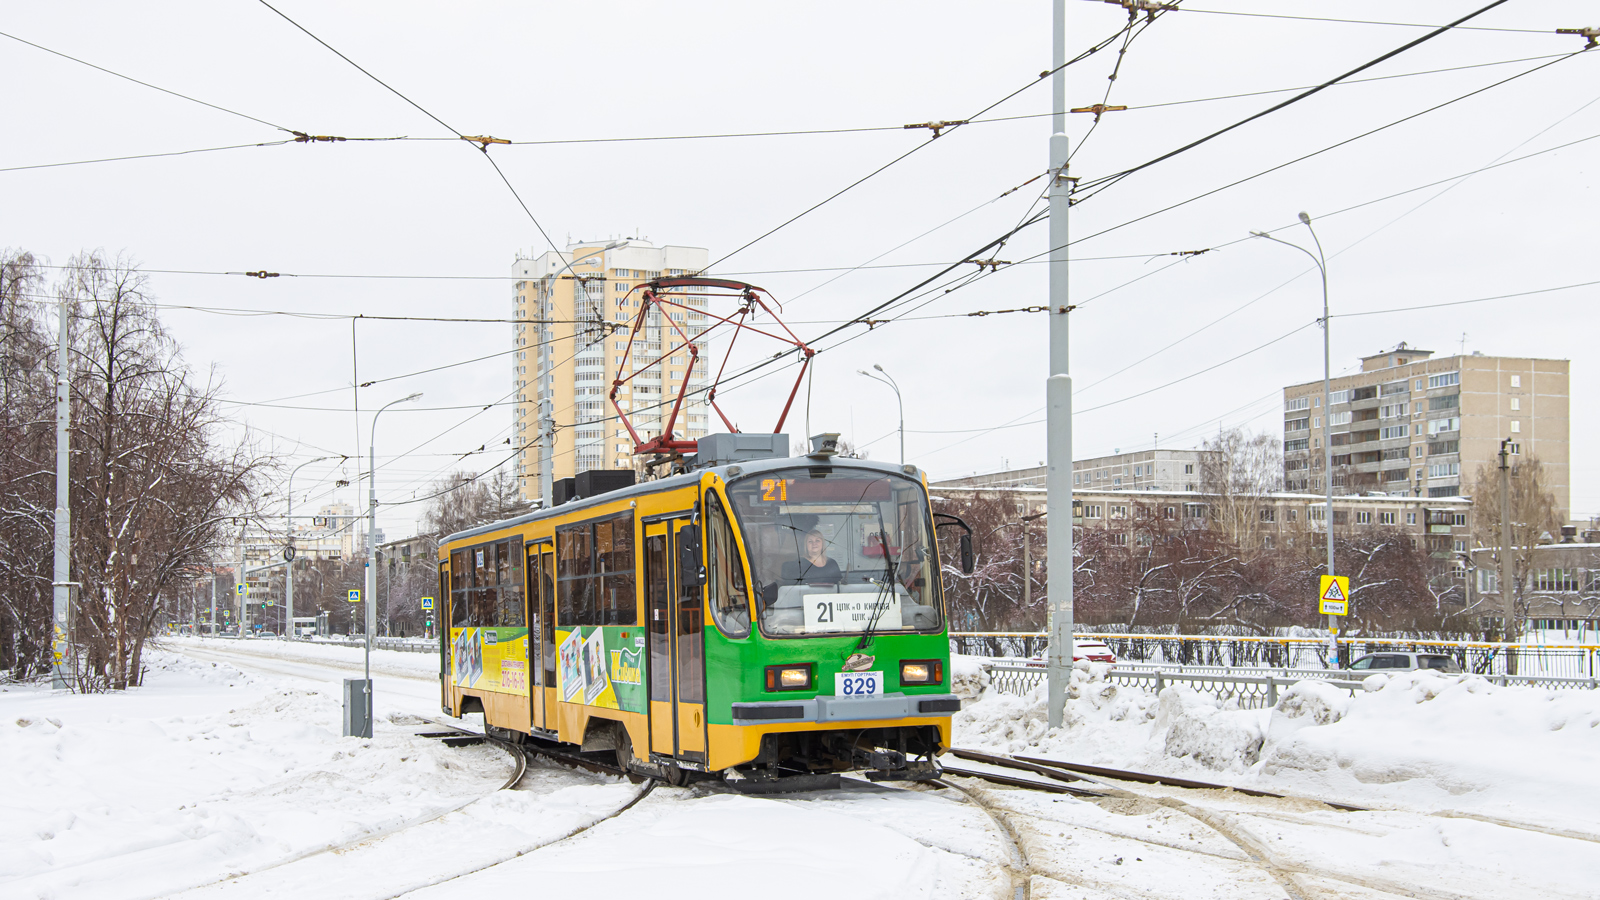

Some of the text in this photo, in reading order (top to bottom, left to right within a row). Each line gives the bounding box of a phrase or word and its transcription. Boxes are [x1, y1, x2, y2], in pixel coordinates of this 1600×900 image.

[762, 479, 787, 501] 21
[817, 602, 833, 622] 21
[837, 603, 850, 611] ЦПК
[852, 613, 865, 621] ЦПК
[843, 677, 876, 695] 829
